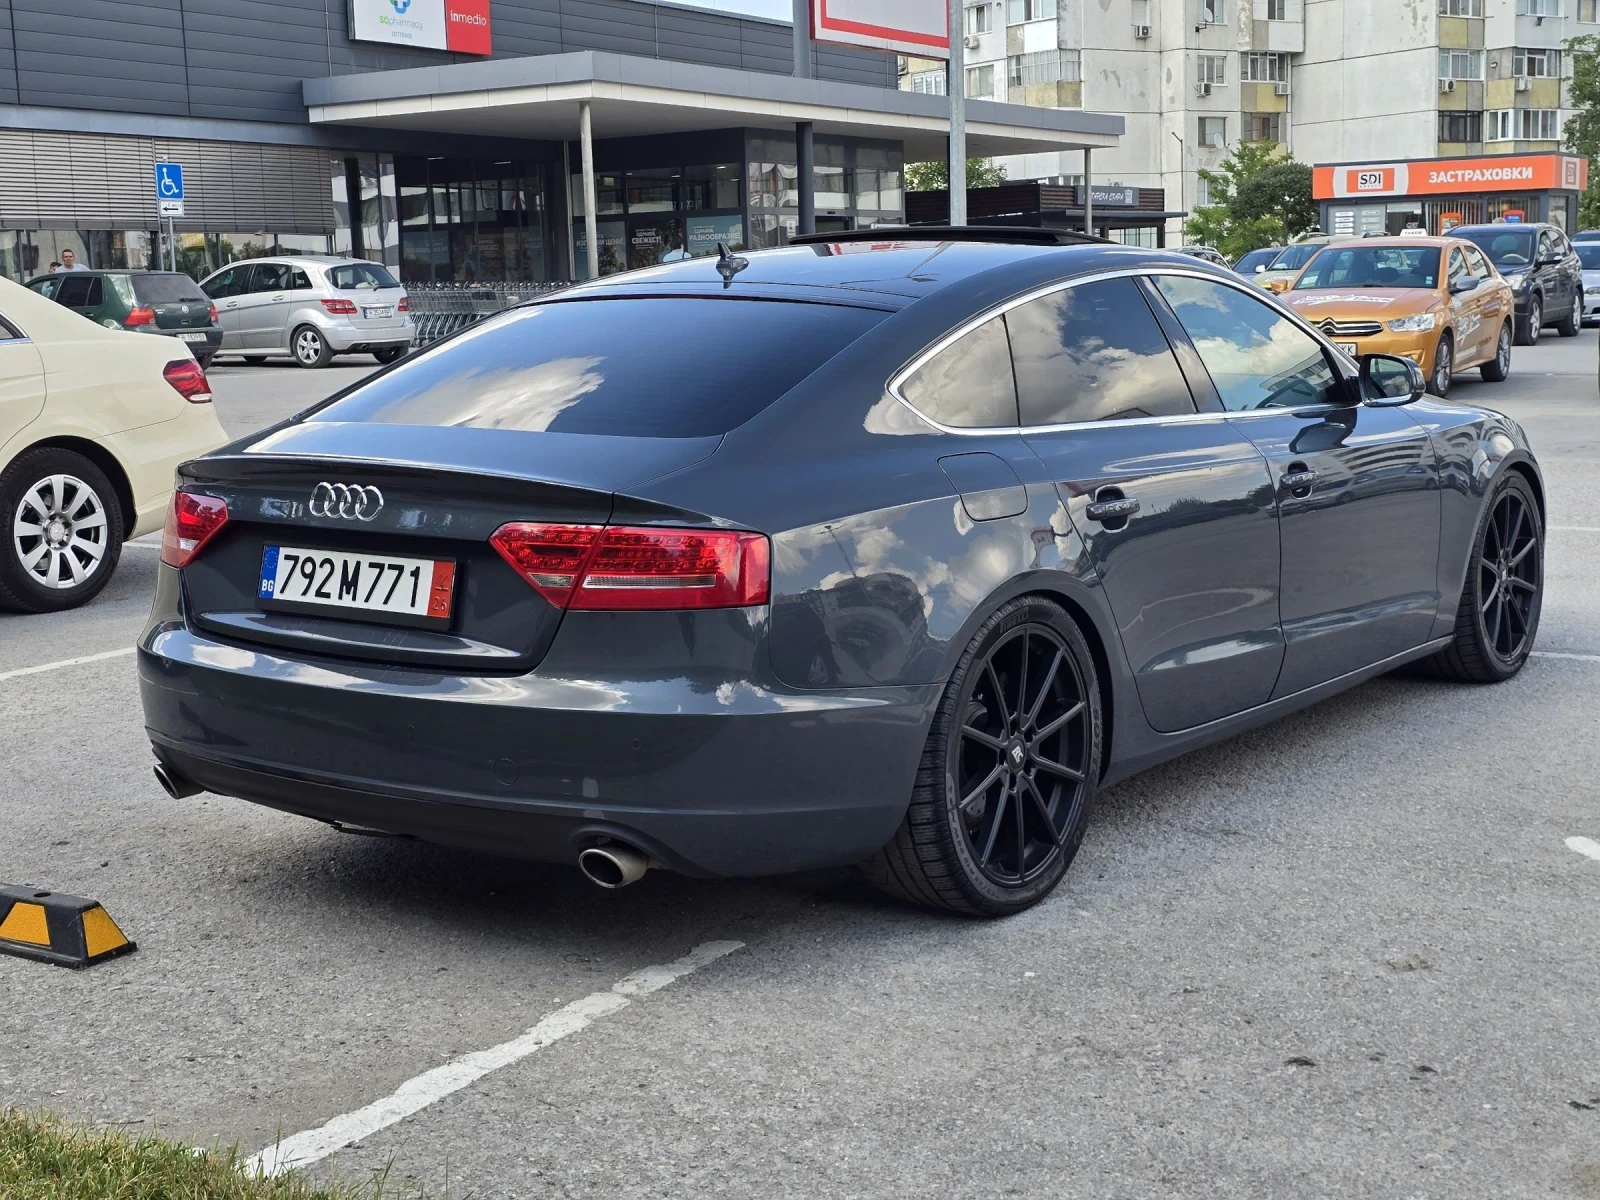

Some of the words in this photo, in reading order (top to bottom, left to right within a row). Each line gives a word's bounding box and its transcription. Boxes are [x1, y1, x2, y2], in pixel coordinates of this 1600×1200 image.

[450, 10, 487, 26] inmedio
[1360, 173, 1381, 185] SDI
[1428, 166, 1533, 184] ЗАСТРАХОВКИ
[631, 235, 662, 244] СВЕЖЕСТ!
[689, 231, 741, 241] РАЗНООБРАЗИЕ!
[261, 579, 274, 592] BG
[279, 554, 421, 608] 792M771
[433, 596, 448, 611] 26
